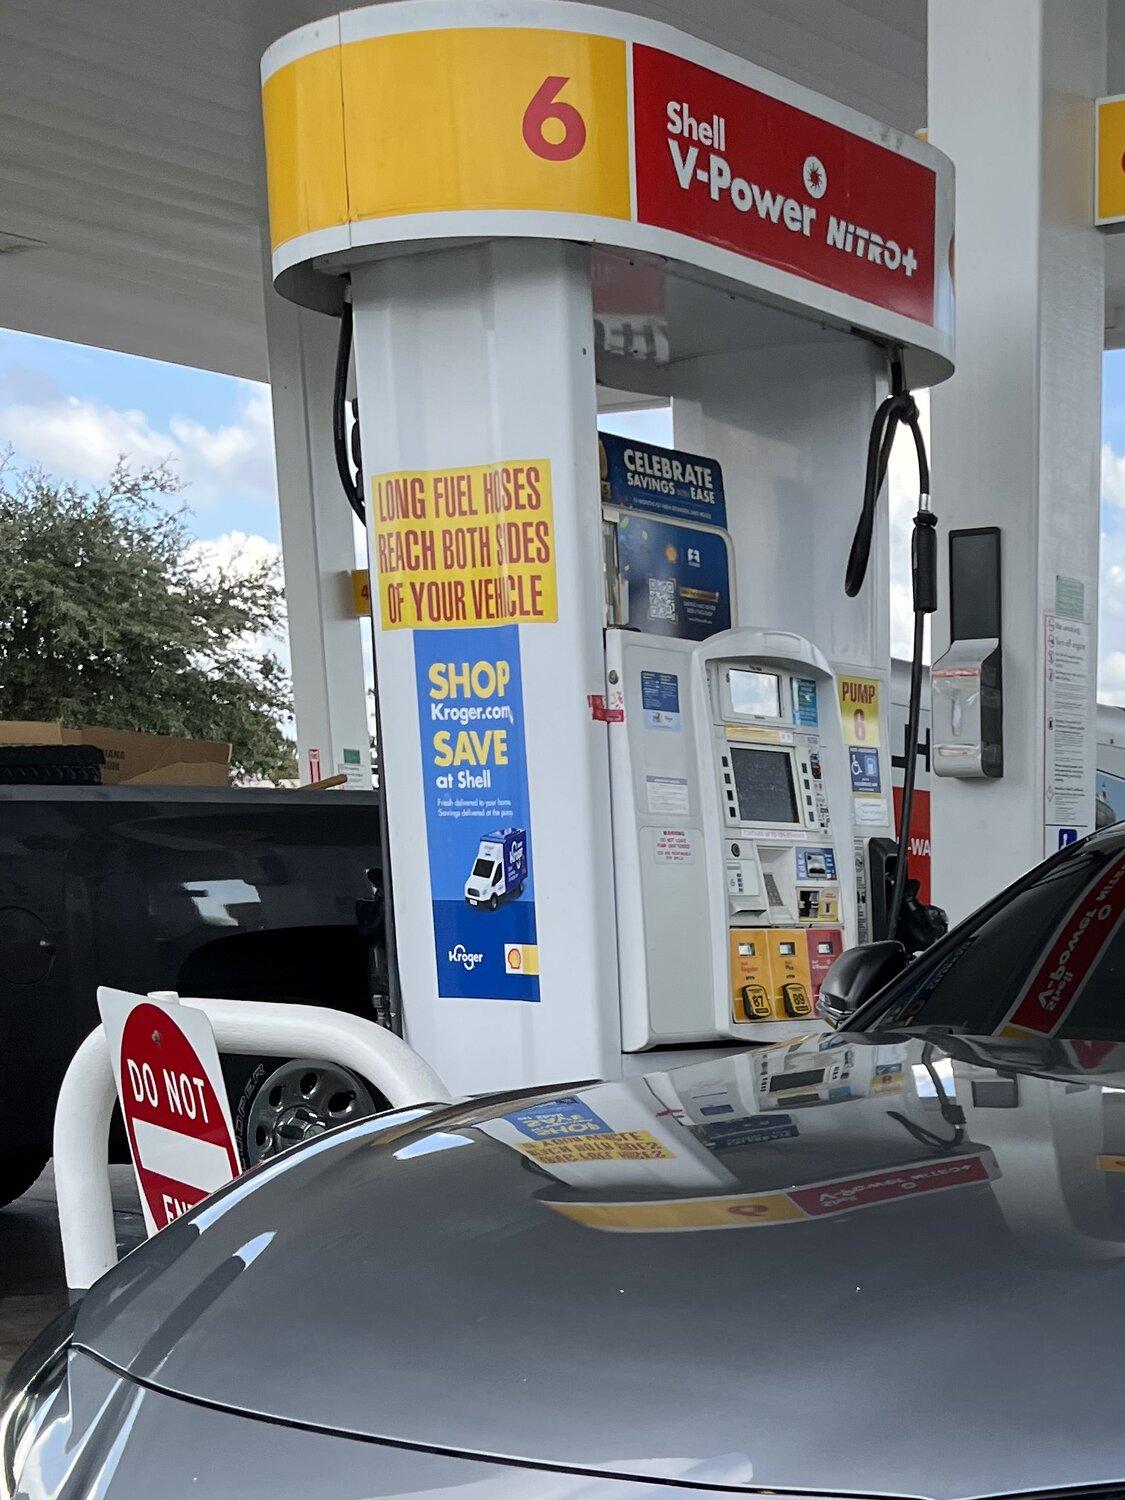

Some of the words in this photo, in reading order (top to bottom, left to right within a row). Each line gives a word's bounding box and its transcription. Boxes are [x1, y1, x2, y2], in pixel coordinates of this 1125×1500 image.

[522, 76, 586, 161] 6
[666, 101, 726, 152] Shell
[667, 139, 816, 237] V-Power
[624, 448, 714, 489] CELEBRATE
[627, 472, 675, 495] SAVINGS
[691, 487, 715, 504] EASE
[378, 477, 426, 522] LONG
[433, 474, 478, 518] FUEL
[483, 466, 541, 514] HOSES
[378, 529, 436, 574] REACH
[442, 525, 491, 569] BOTH
[496, 520, 550, 565] SIDES
[388, 582, 404, 623] OF
[409, 580, 466, 622] YOUR
[471, 574, 544, 620] VEHICLE
[429, 660, 510, 700] SHOP
[842, 681, 876, 704] PUMP
[853, 708, 865, 741] 6
[433, 729, 509, 767] SAVE
[436, 773, 454, 789] at
[458, 769, 492, 789] Shell
[448, 944, 484, 970] Kroger
[751, 994, 765, 1007] 87
[127, 1058, 159, 1108] DO
[162, 1068, 209, 1124] NOT
